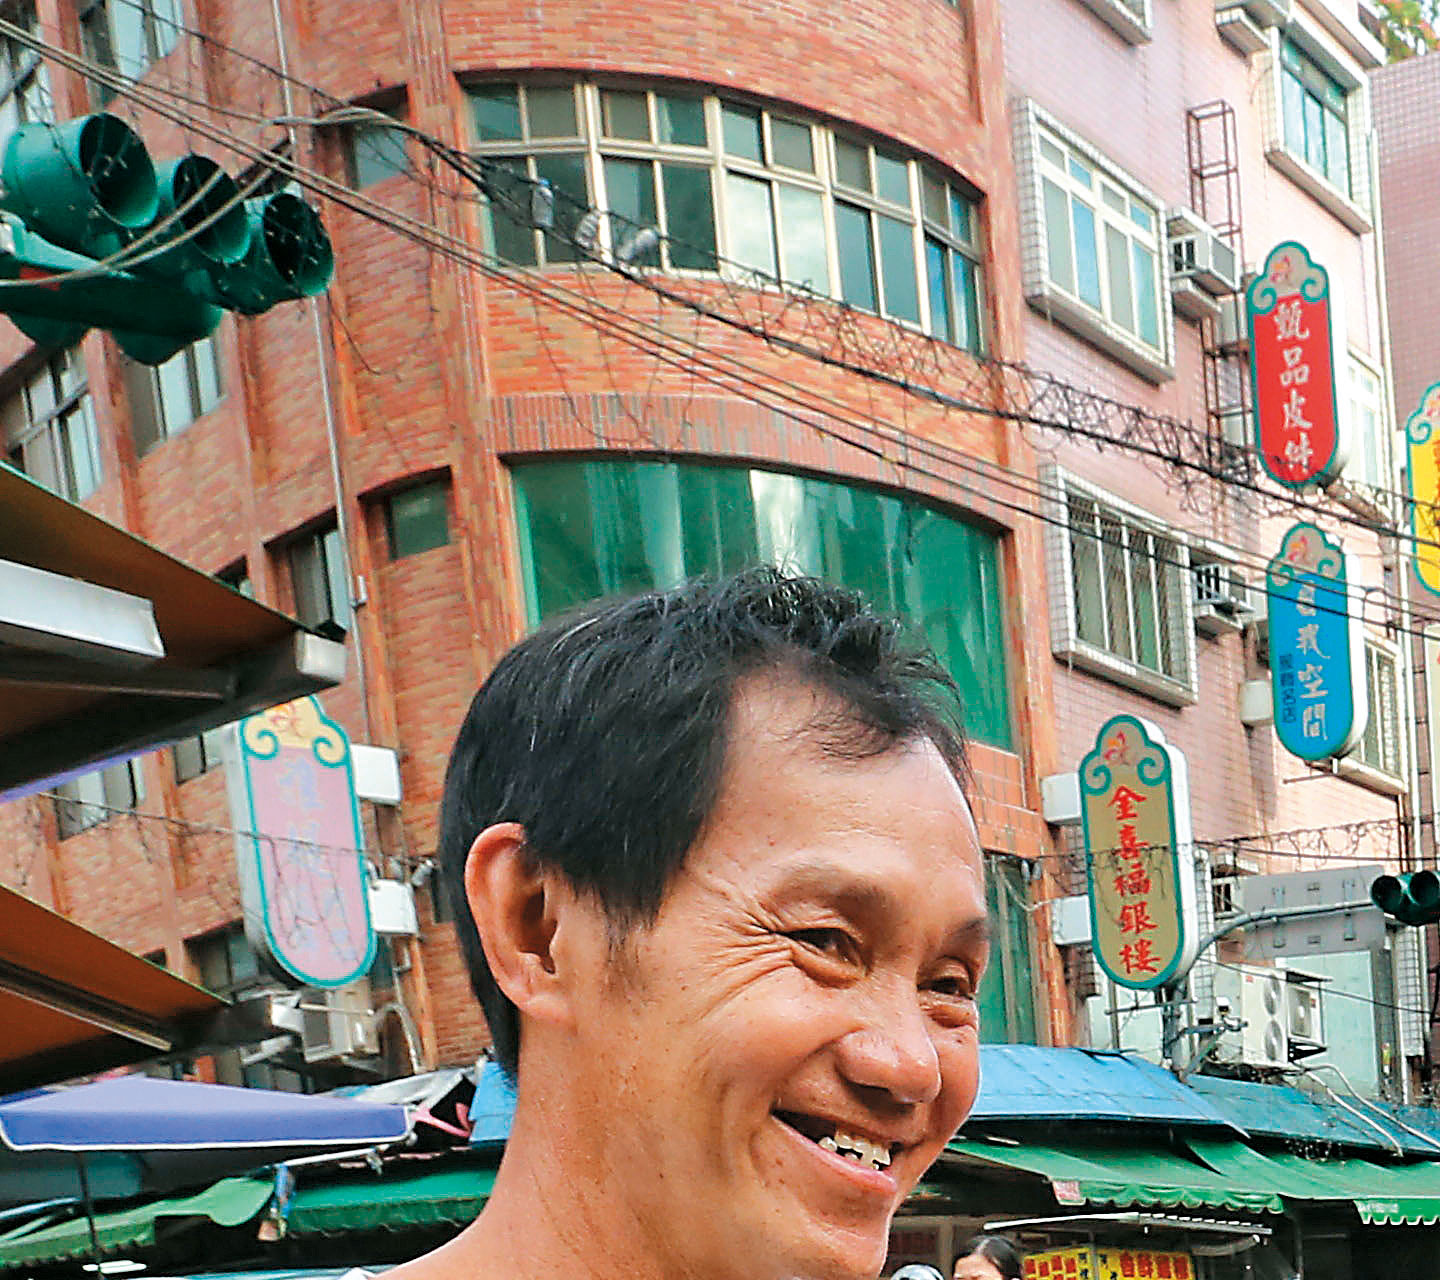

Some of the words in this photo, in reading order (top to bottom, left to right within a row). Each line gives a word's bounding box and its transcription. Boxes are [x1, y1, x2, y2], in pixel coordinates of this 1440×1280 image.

[1106, 784, 1162, 975] 金喜福銀樓
